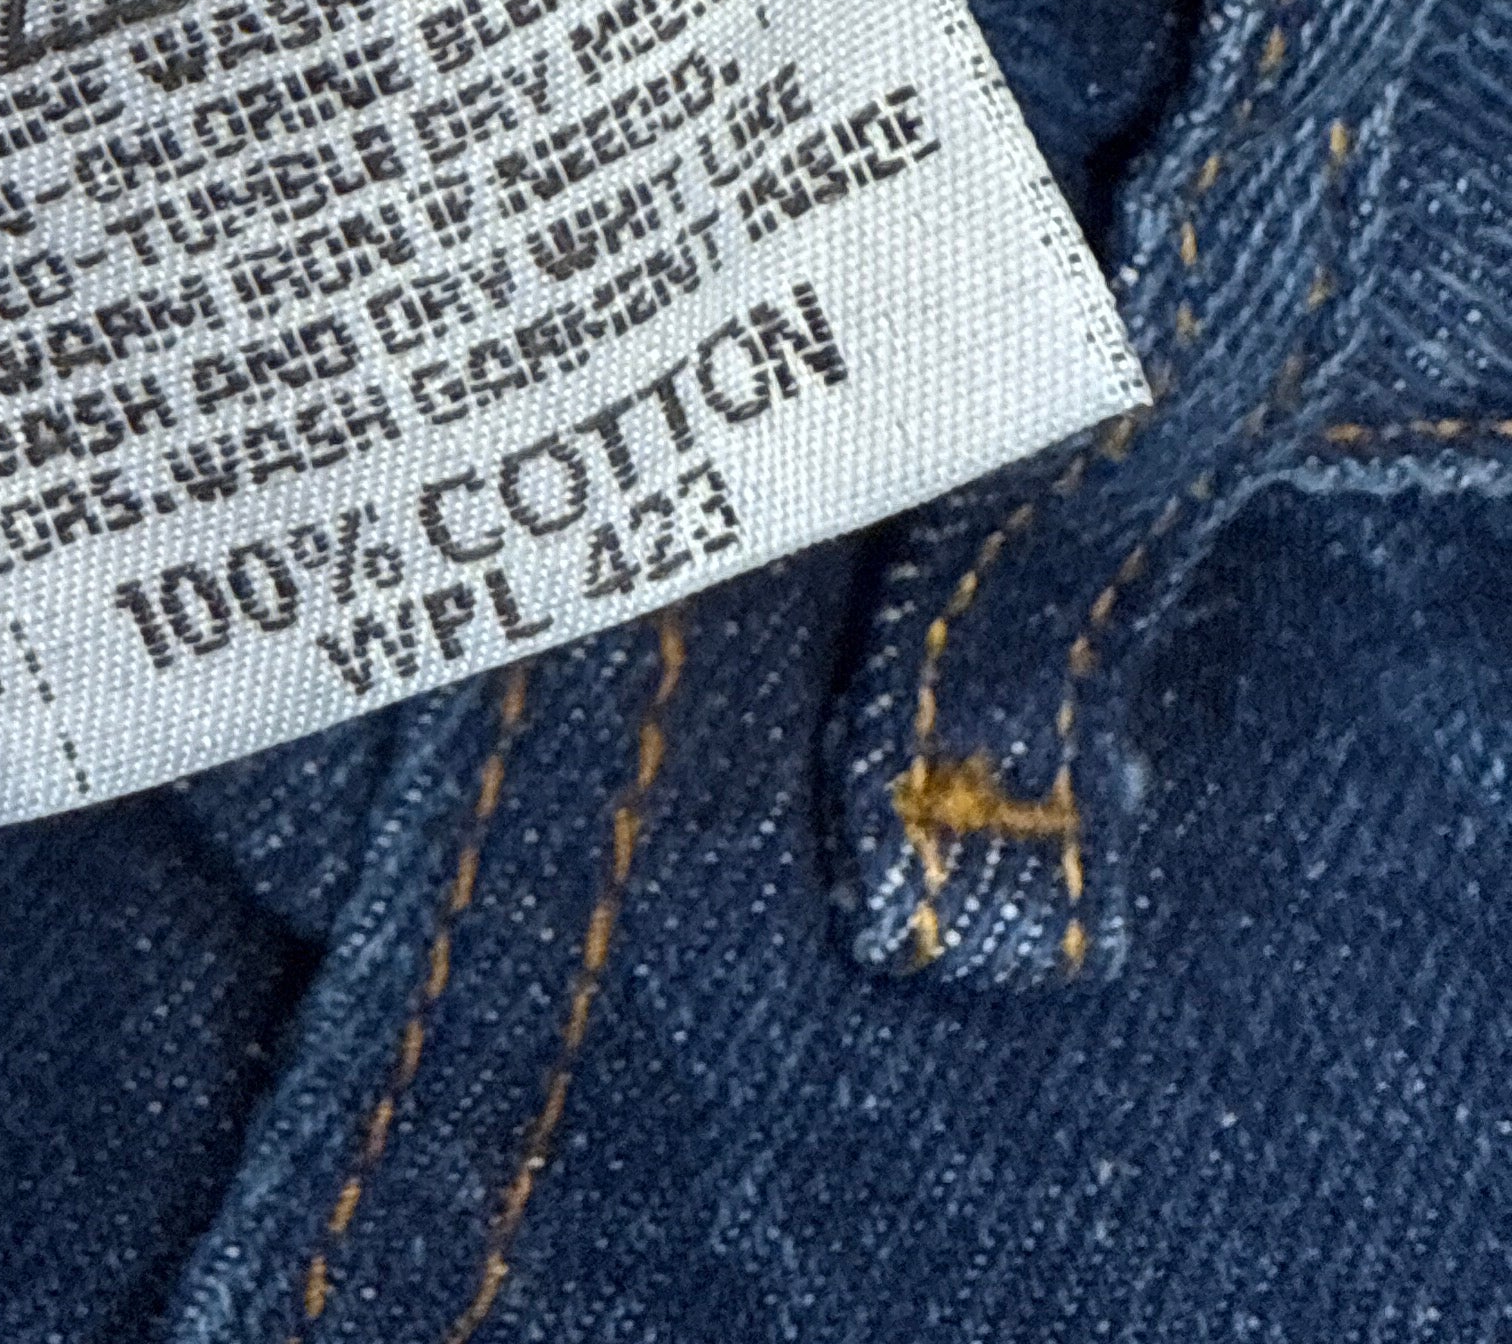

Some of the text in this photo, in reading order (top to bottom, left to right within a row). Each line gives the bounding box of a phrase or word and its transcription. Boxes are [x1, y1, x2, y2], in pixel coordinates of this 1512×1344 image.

[412, 50, 552, 165] DRY
[191, 315, 359, 413] AND
[365, 247, 517, 354] DRY
[697, 62, 813, 188] LIKE
[225, 204, 417, 322] IRON
[406, 171, 474, 249] IF
[410, 210, 723, 426] GARMENT
[116, 280, 849, 670] 100% COTTON
[317, 459, 741, 696] WPL 423
